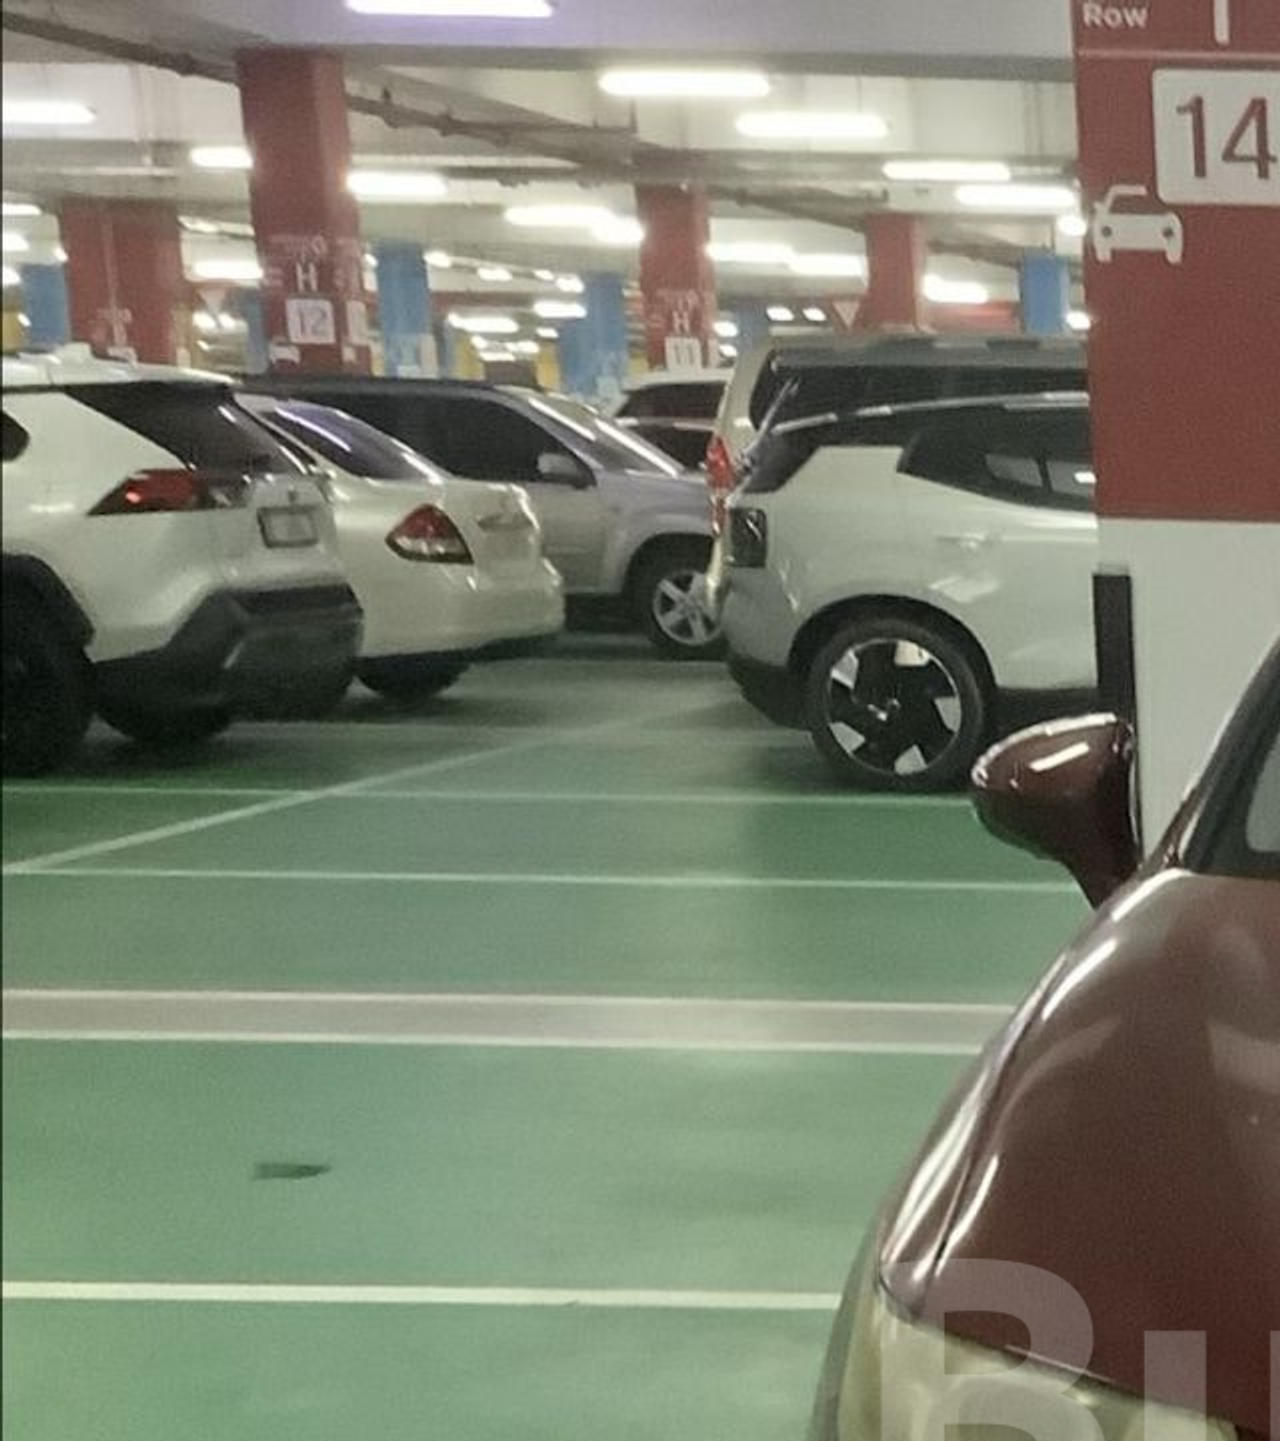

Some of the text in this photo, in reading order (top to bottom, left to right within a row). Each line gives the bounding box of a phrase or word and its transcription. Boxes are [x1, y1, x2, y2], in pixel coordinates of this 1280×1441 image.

[1083, 2, 1147, 28] Row
[1176, 96, 1278, 179] 14
[295, 262, 317, 292] H
[296, 306, 328, 338] 12
